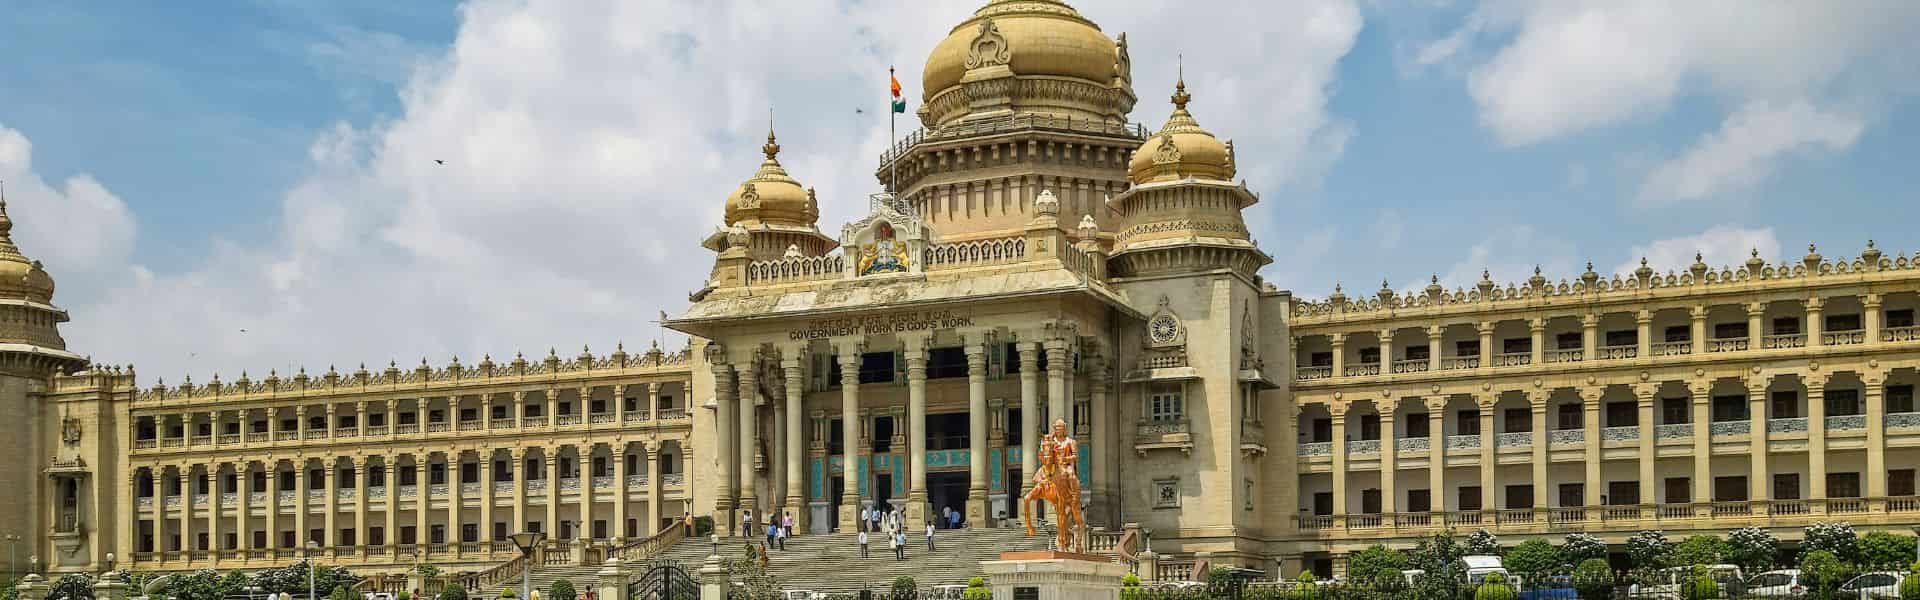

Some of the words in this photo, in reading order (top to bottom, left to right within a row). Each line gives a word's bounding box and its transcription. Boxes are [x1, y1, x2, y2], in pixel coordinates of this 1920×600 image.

[790, 326, 860, 340] GOVERNMENT
[864, 323, 892, 335] WORK
[895, 321, 905, 333] IS
[941, 317, 975, 328] WORK.
